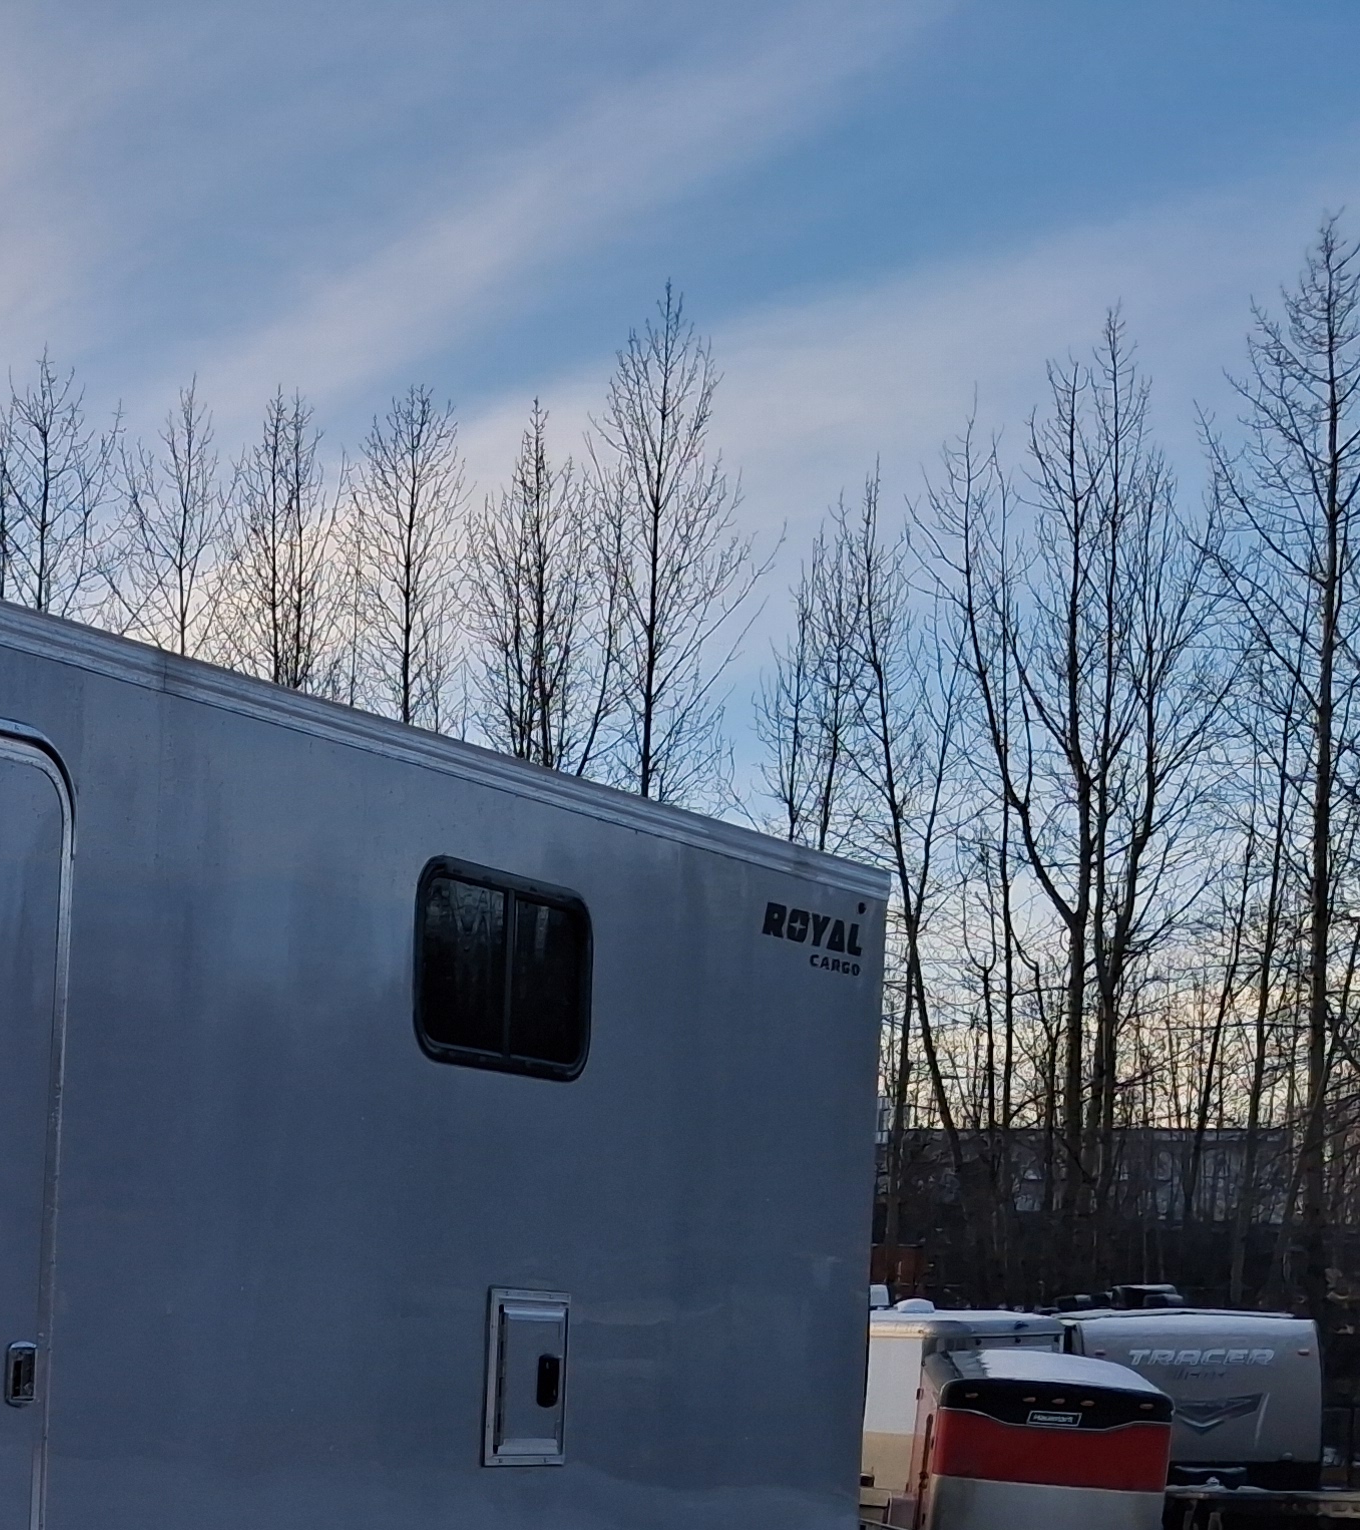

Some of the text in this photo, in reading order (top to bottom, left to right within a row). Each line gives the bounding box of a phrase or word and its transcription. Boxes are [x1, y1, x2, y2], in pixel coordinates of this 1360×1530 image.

[762, 902, 862, 956] ROYAL
[809, 954, 861, 976] CARGO
[1128, 1349, 1275, 1366] TRACER
